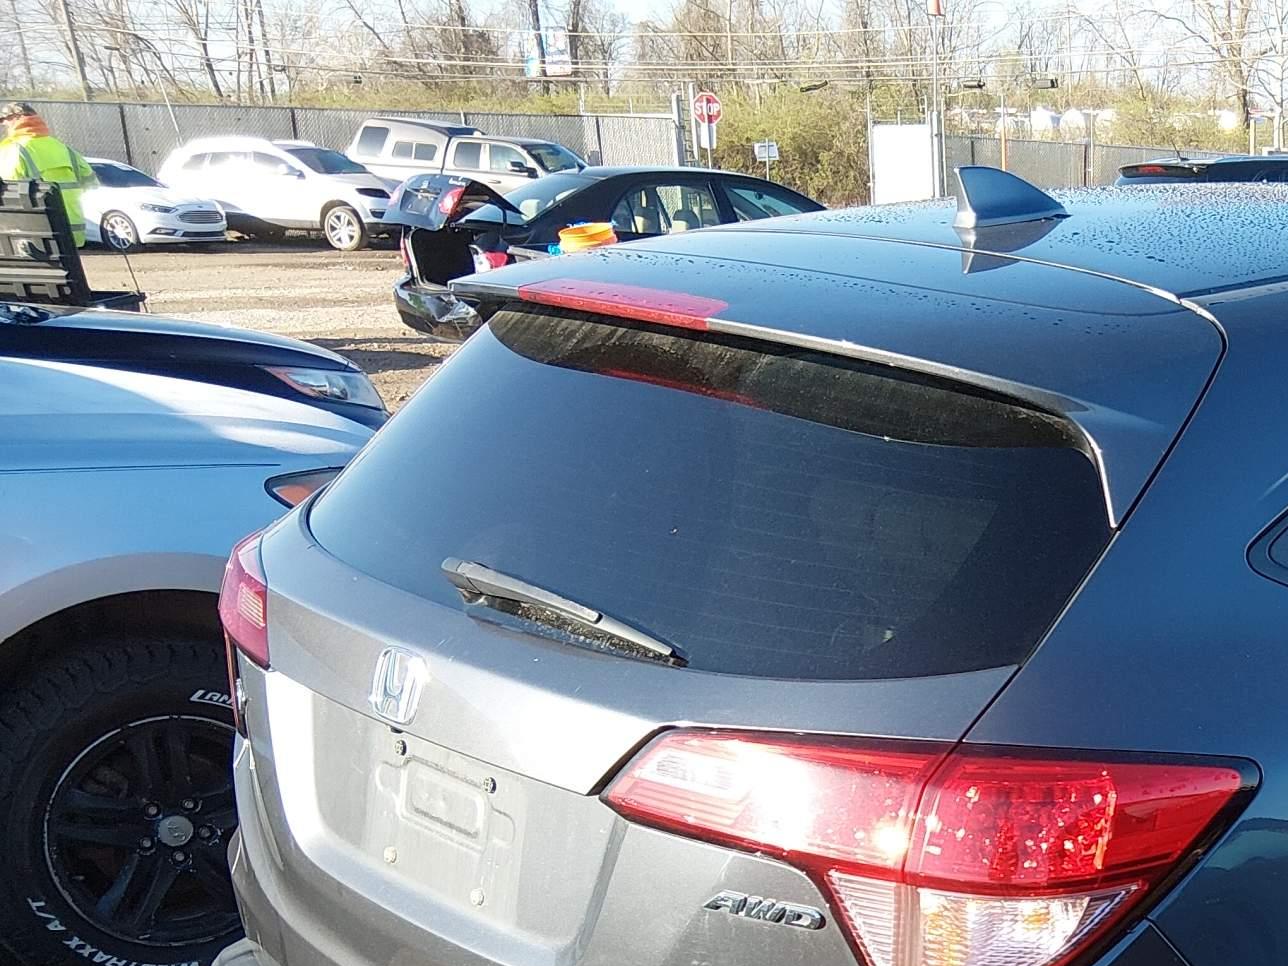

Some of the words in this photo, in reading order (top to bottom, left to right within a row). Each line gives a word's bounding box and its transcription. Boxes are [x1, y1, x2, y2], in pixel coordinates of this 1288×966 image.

[695, 102, 720, 115] STOP
[26, 896, 67, 932] A/T
[703, 889, 827, 931] AWD
